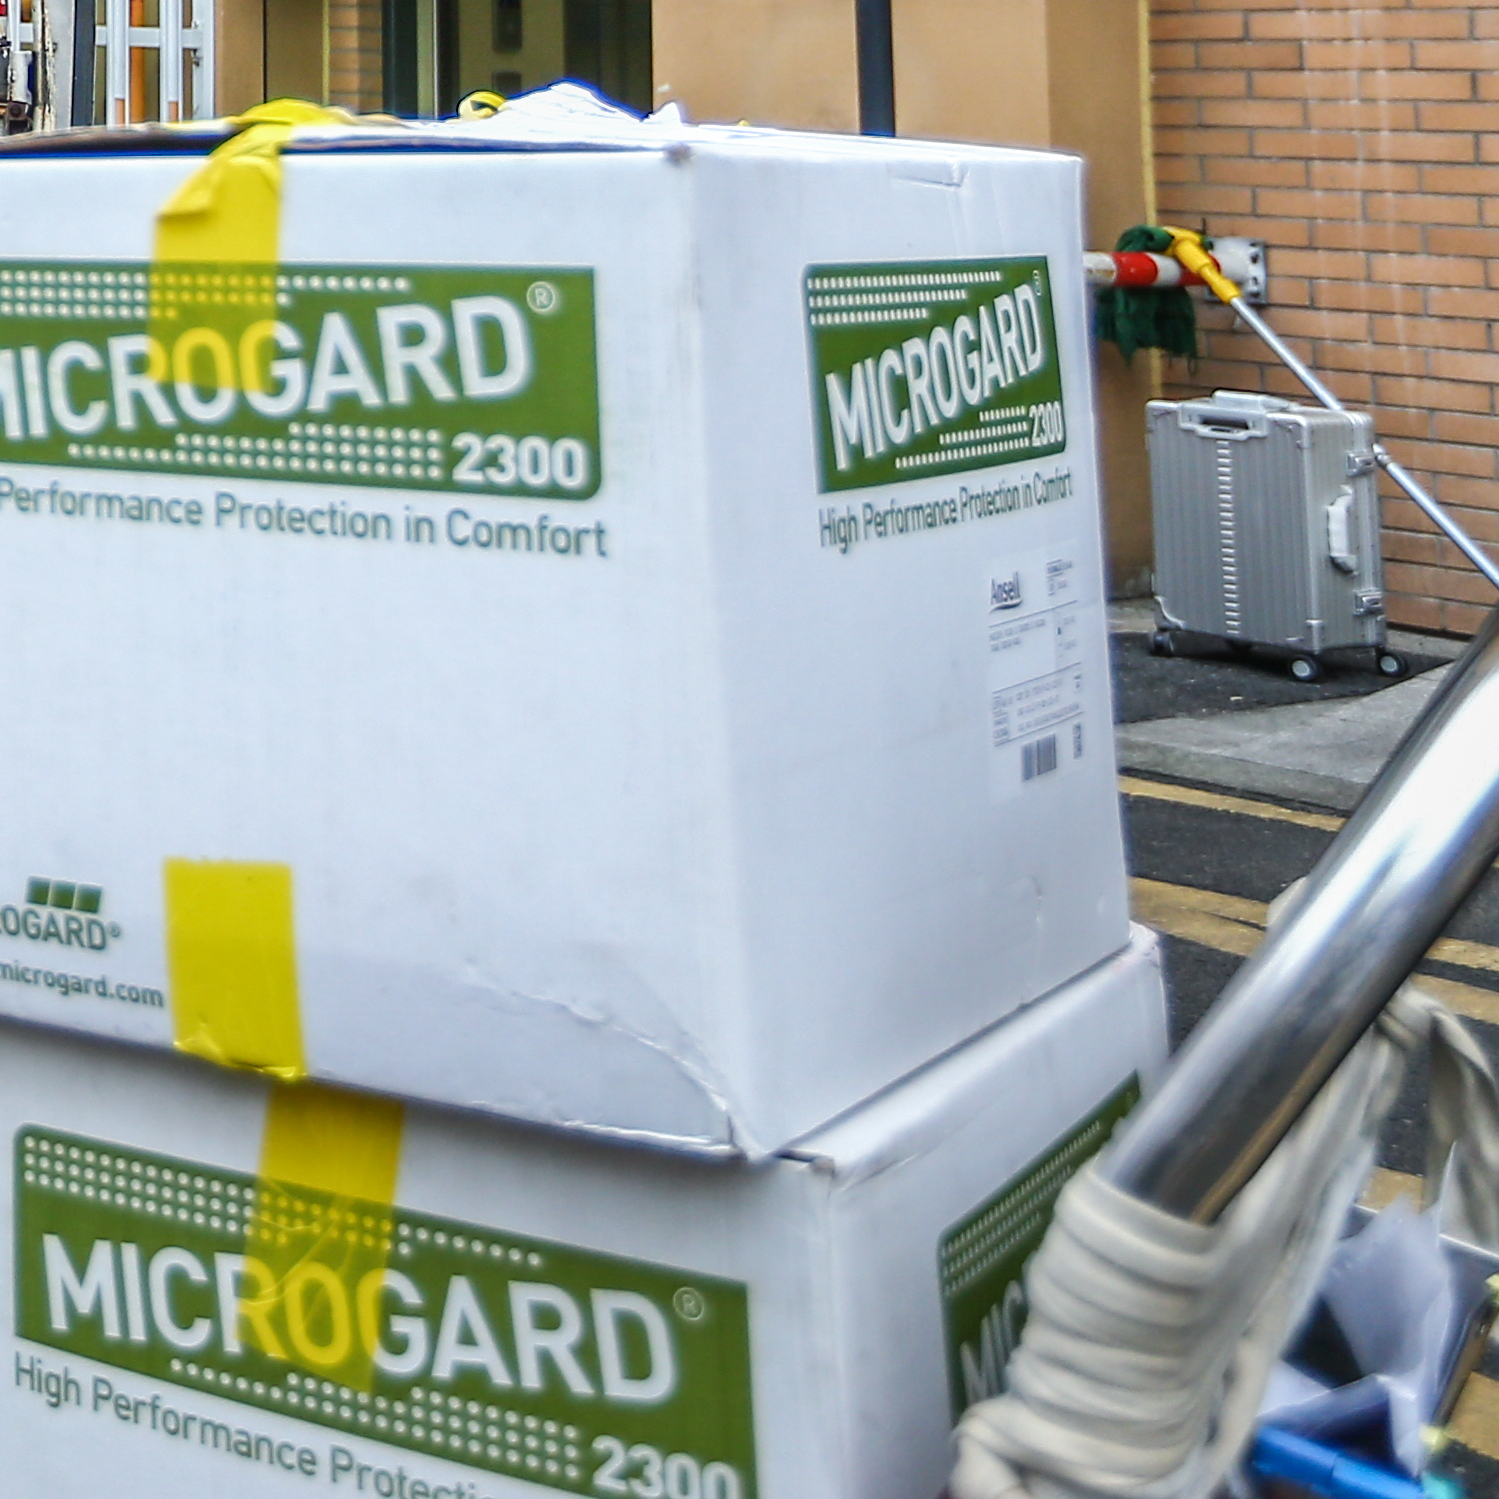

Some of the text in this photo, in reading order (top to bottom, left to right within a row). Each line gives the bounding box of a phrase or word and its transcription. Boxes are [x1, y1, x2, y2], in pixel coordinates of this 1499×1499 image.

[1029, 401, 1063, 447] 2300
[451, 432, 588, 489] 2300
[214, 490, 393, 543] Protection
[404, 503, 436, 545] in
[446, 507, 610, 559] Comfort
[818, 467, 1074, 554] High Performance Protection in Comfort
[990, 571, 1021, 605] Ansell
[14, 1353, 81, 1408] High
[92, 1373, 317, 1475] Performance
[591, 1433, 740, 1499] 2300
